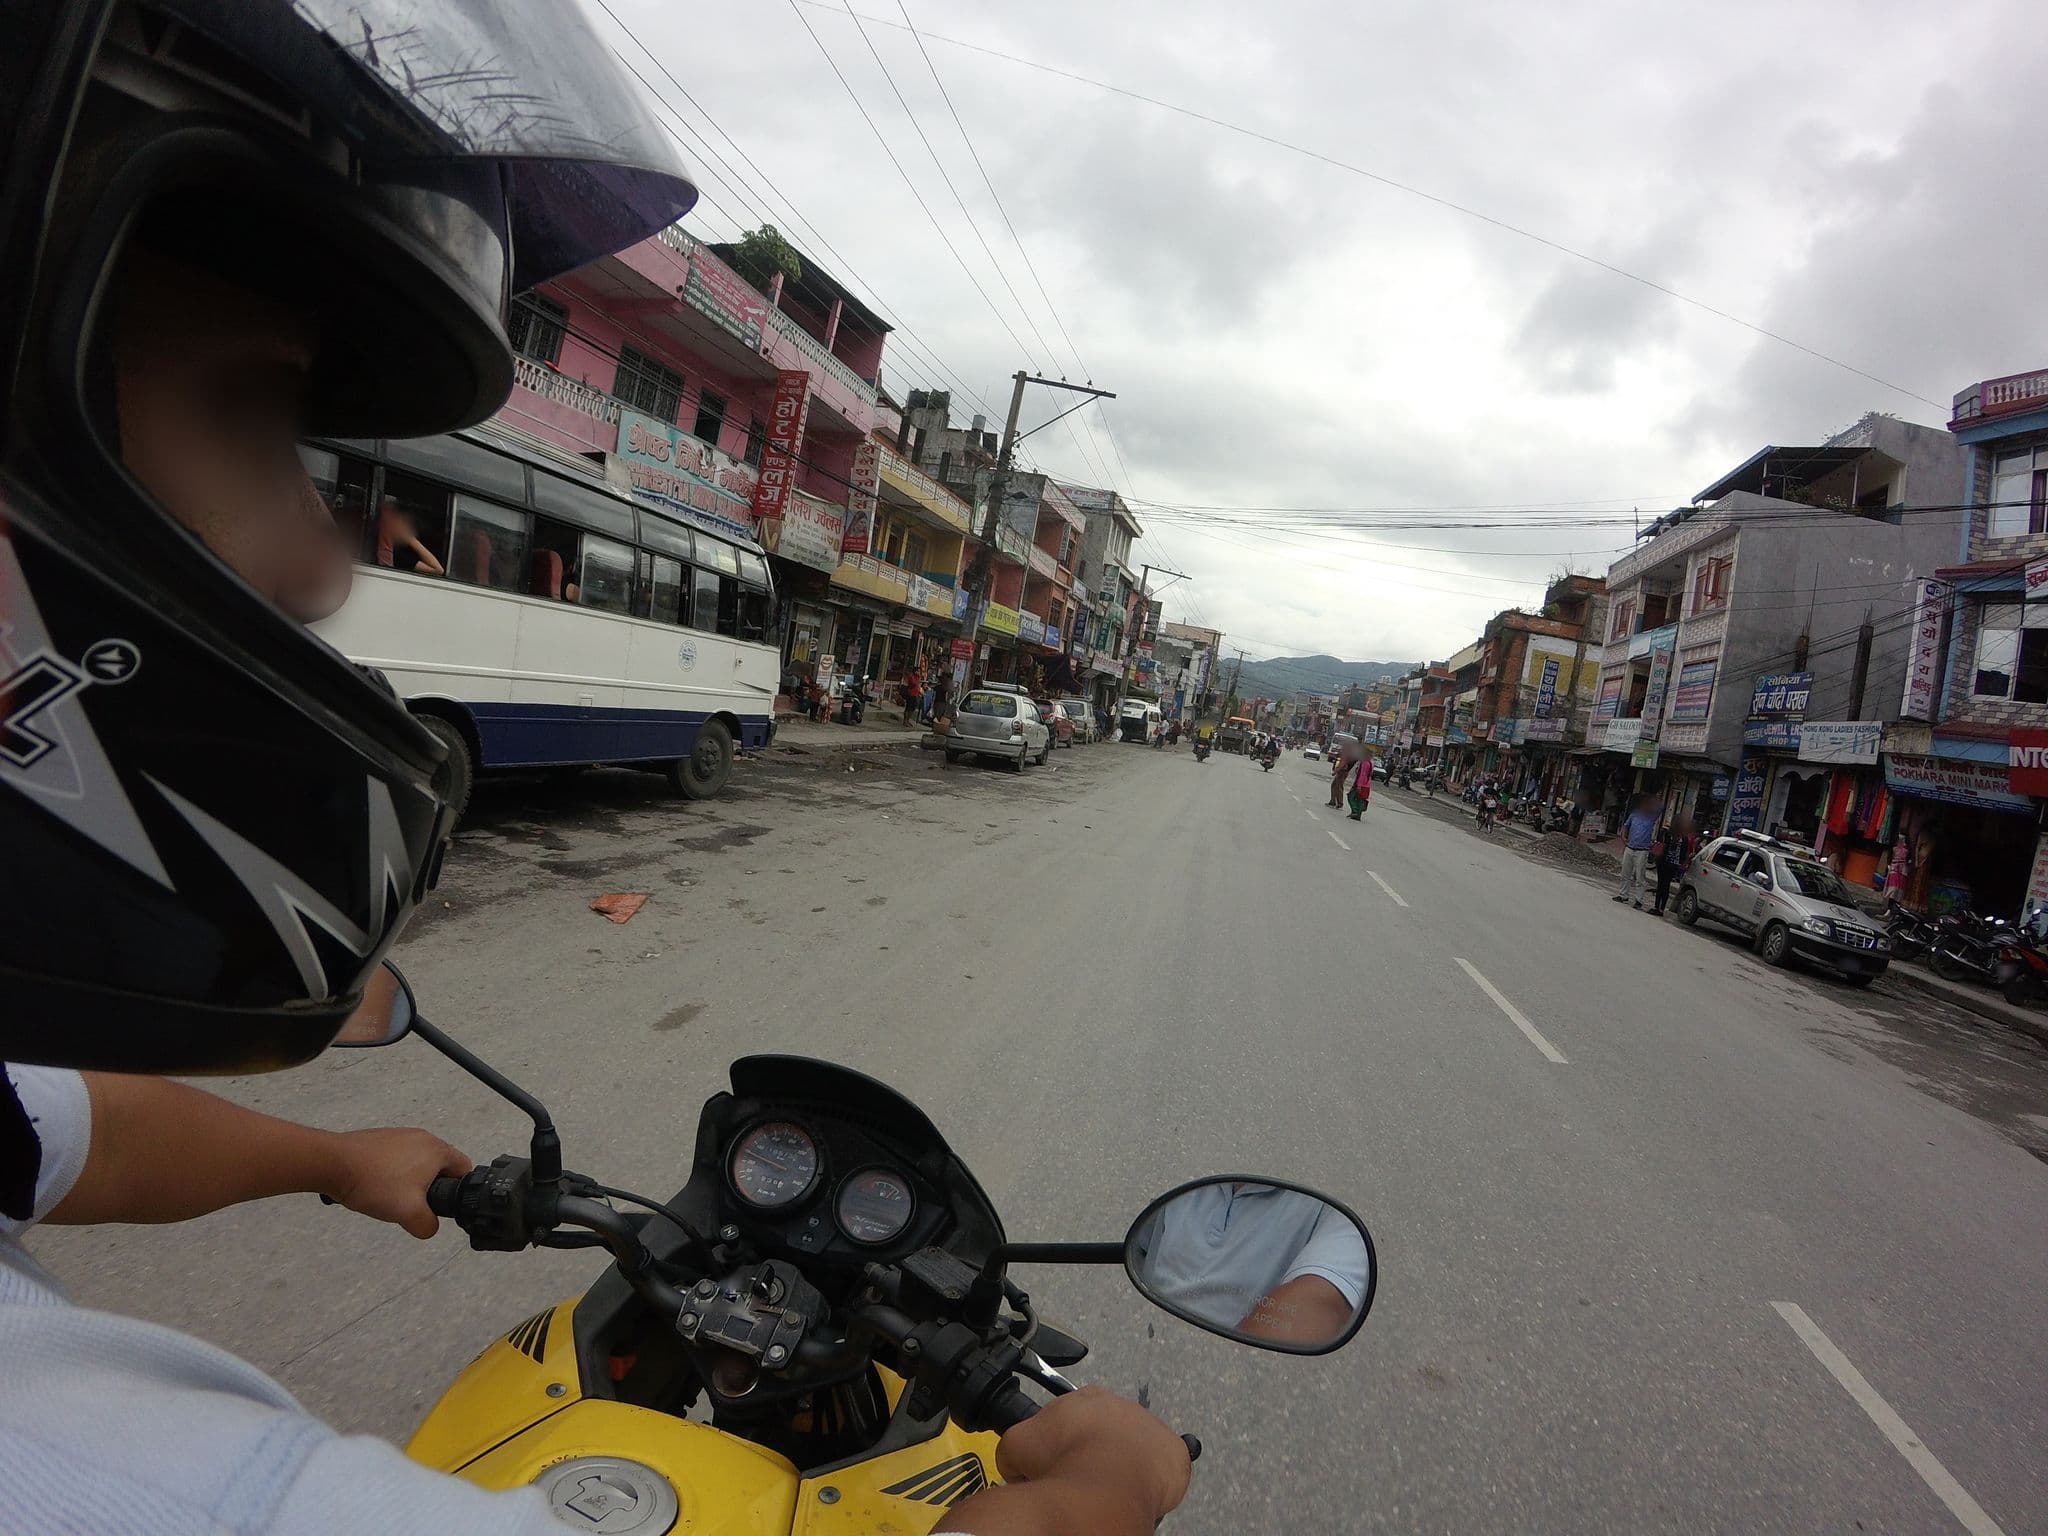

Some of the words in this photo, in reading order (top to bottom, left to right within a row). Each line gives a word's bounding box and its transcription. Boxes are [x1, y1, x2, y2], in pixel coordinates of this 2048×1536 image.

[1767, 737, 1789, 745] SHOP
[1893, 767, 1945, 784] POKHARA
[1949, 775, 1972, 787] MINI
[1975, 779, 2009, 793] MARK
